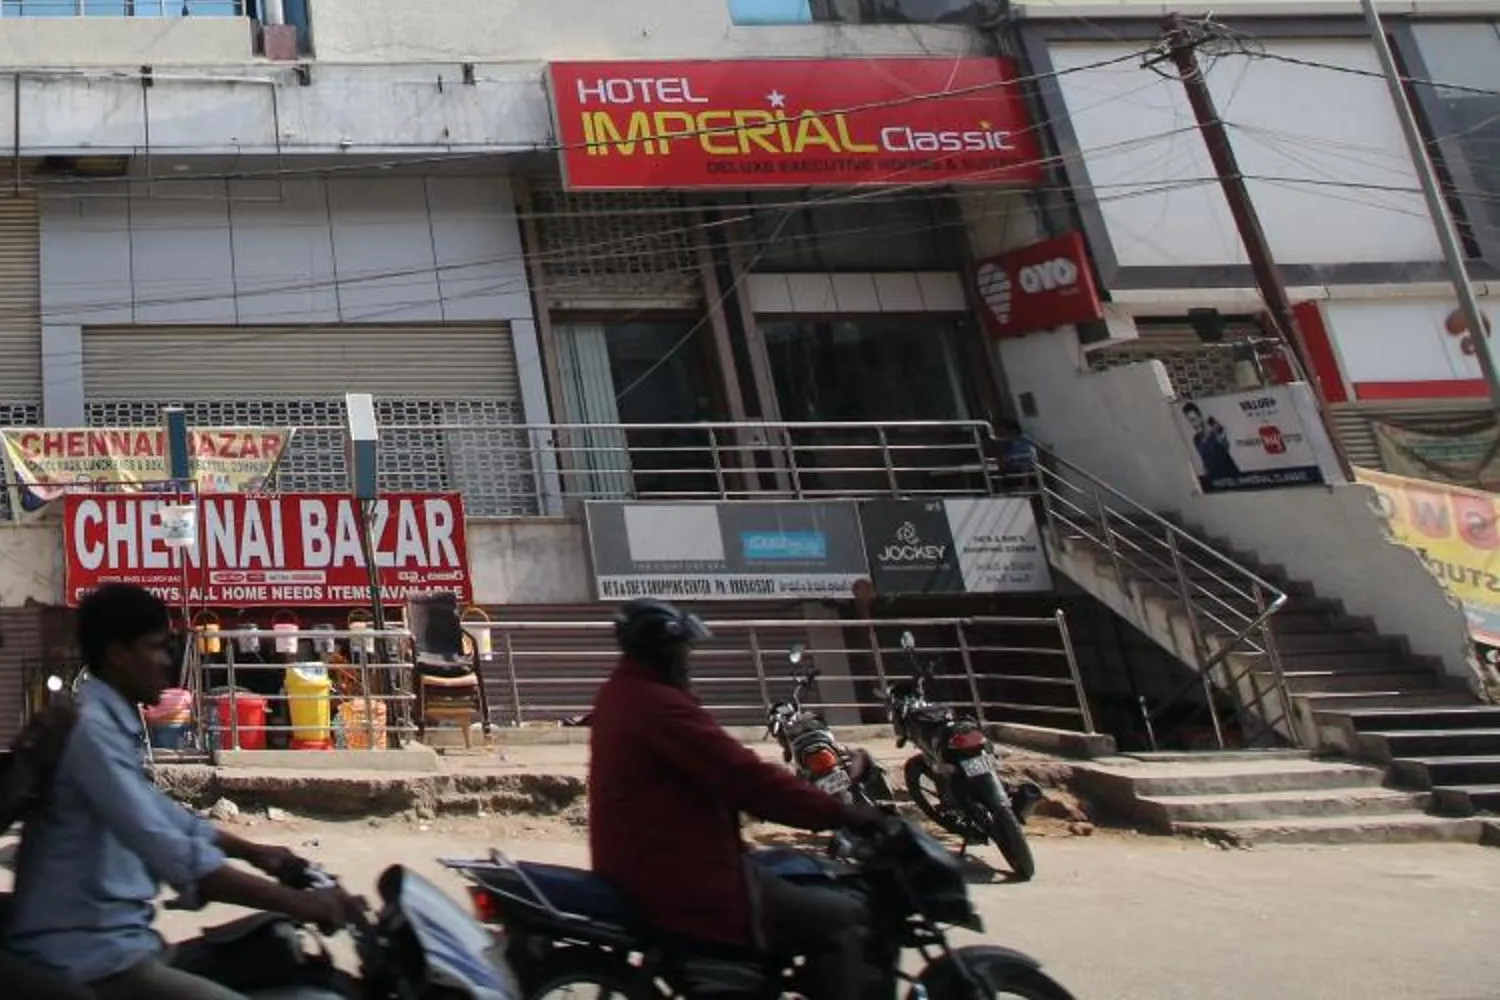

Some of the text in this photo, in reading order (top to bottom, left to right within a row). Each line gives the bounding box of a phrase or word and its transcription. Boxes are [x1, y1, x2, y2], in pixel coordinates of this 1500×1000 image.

[576, 77, 709, 104] HOTEL
[581, 108, 1016, 156] IMPERIAL Classic
[1018, 257, 1078, 294] OYO
[21, 431, 168, 458] CHENNAI
[300, 498, 461, 568] BAZAR
[877, 545, 947, 562] JOCKEY
[222, 587, 266, 601] HOME
[272, 586, 322, 600] NEEDS
[328, 586, 373, 600] ITEMS
